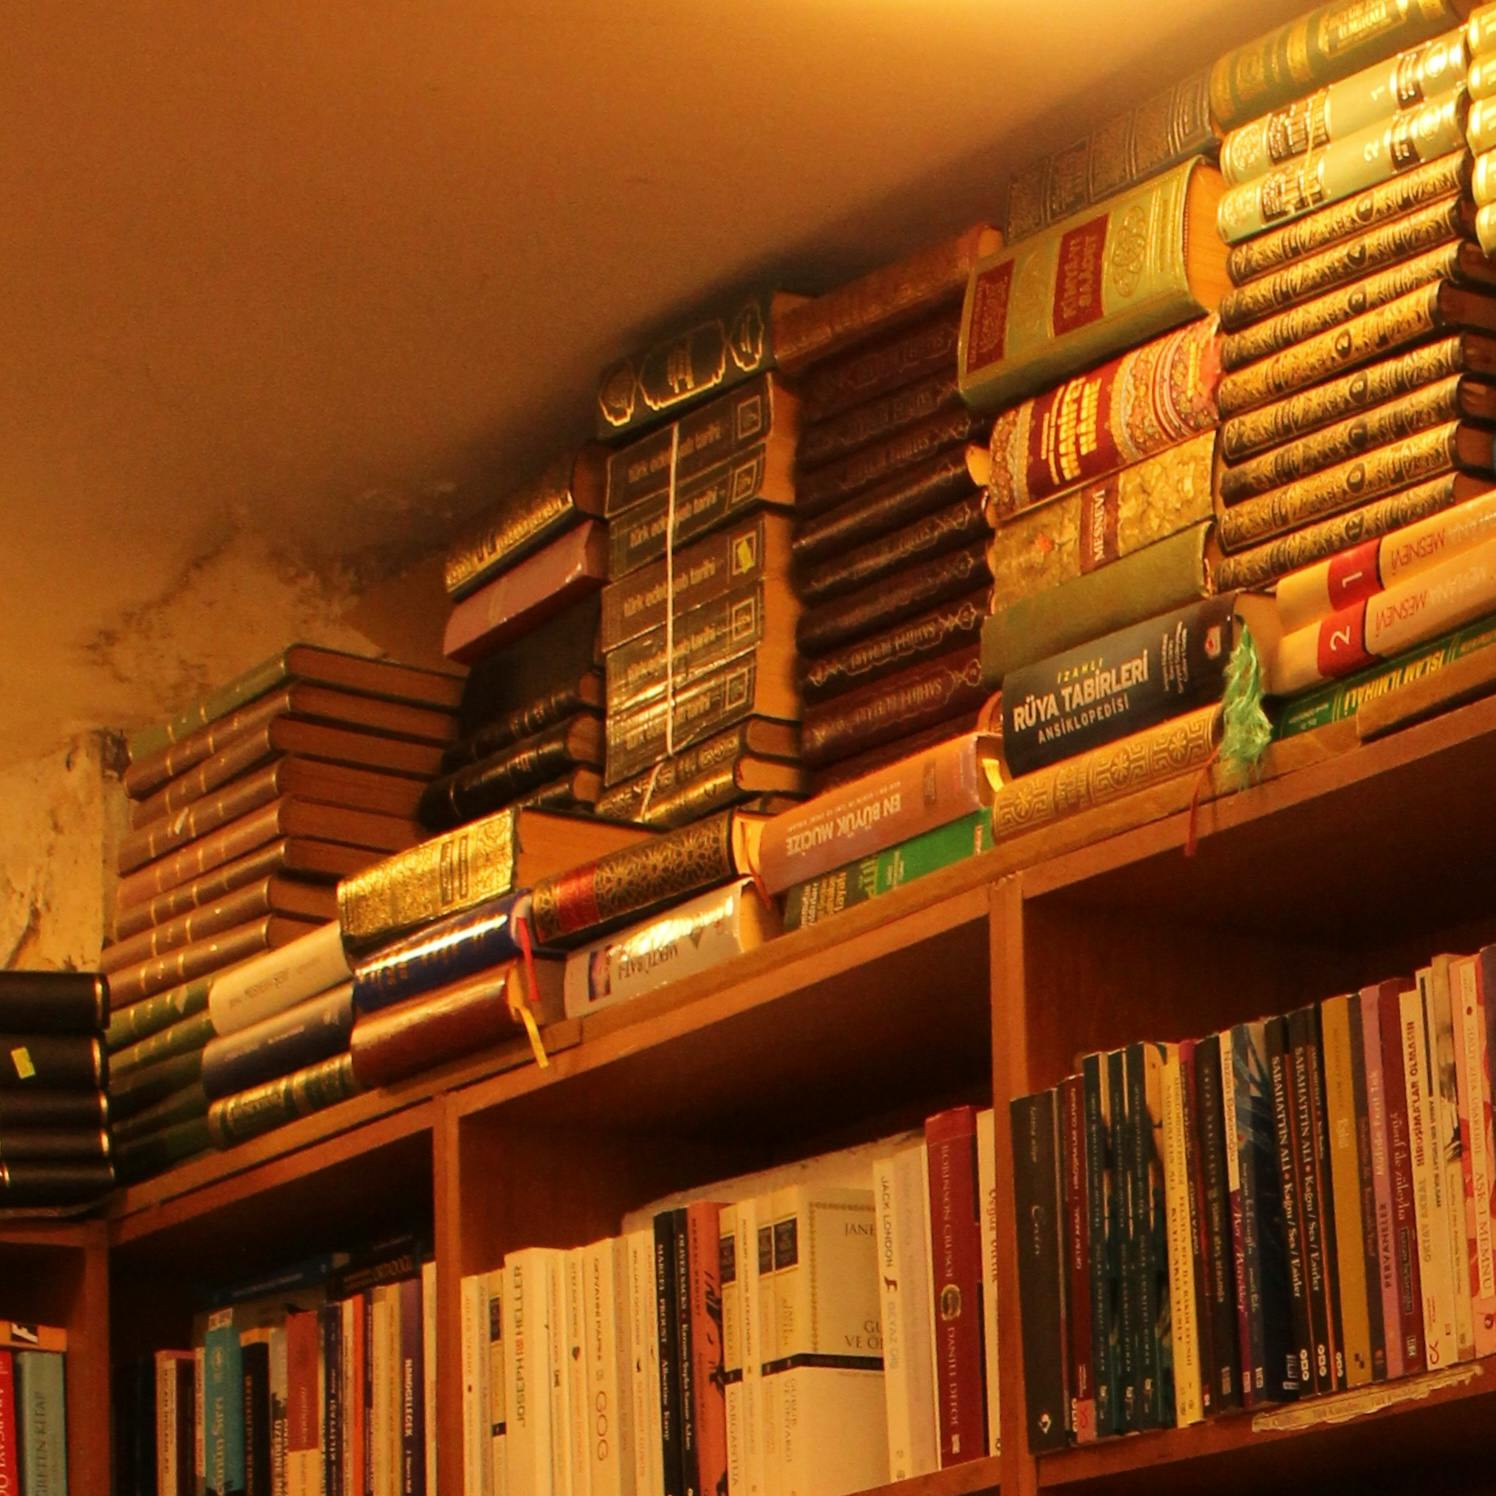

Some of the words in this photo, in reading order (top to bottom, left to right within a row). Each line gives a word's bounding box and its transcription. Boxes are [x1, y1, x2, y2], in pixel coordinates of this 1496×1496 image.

[1342, 571, 1364, 590] 1
[1329, 626, 1351, 652] 2
[1013, 694, 1059, 732] RÜYA
[1061, 649, 1148, 712] TABİRLERİ
[1038, 693, 1129, 744] ANSİKLOPEDİSİ
